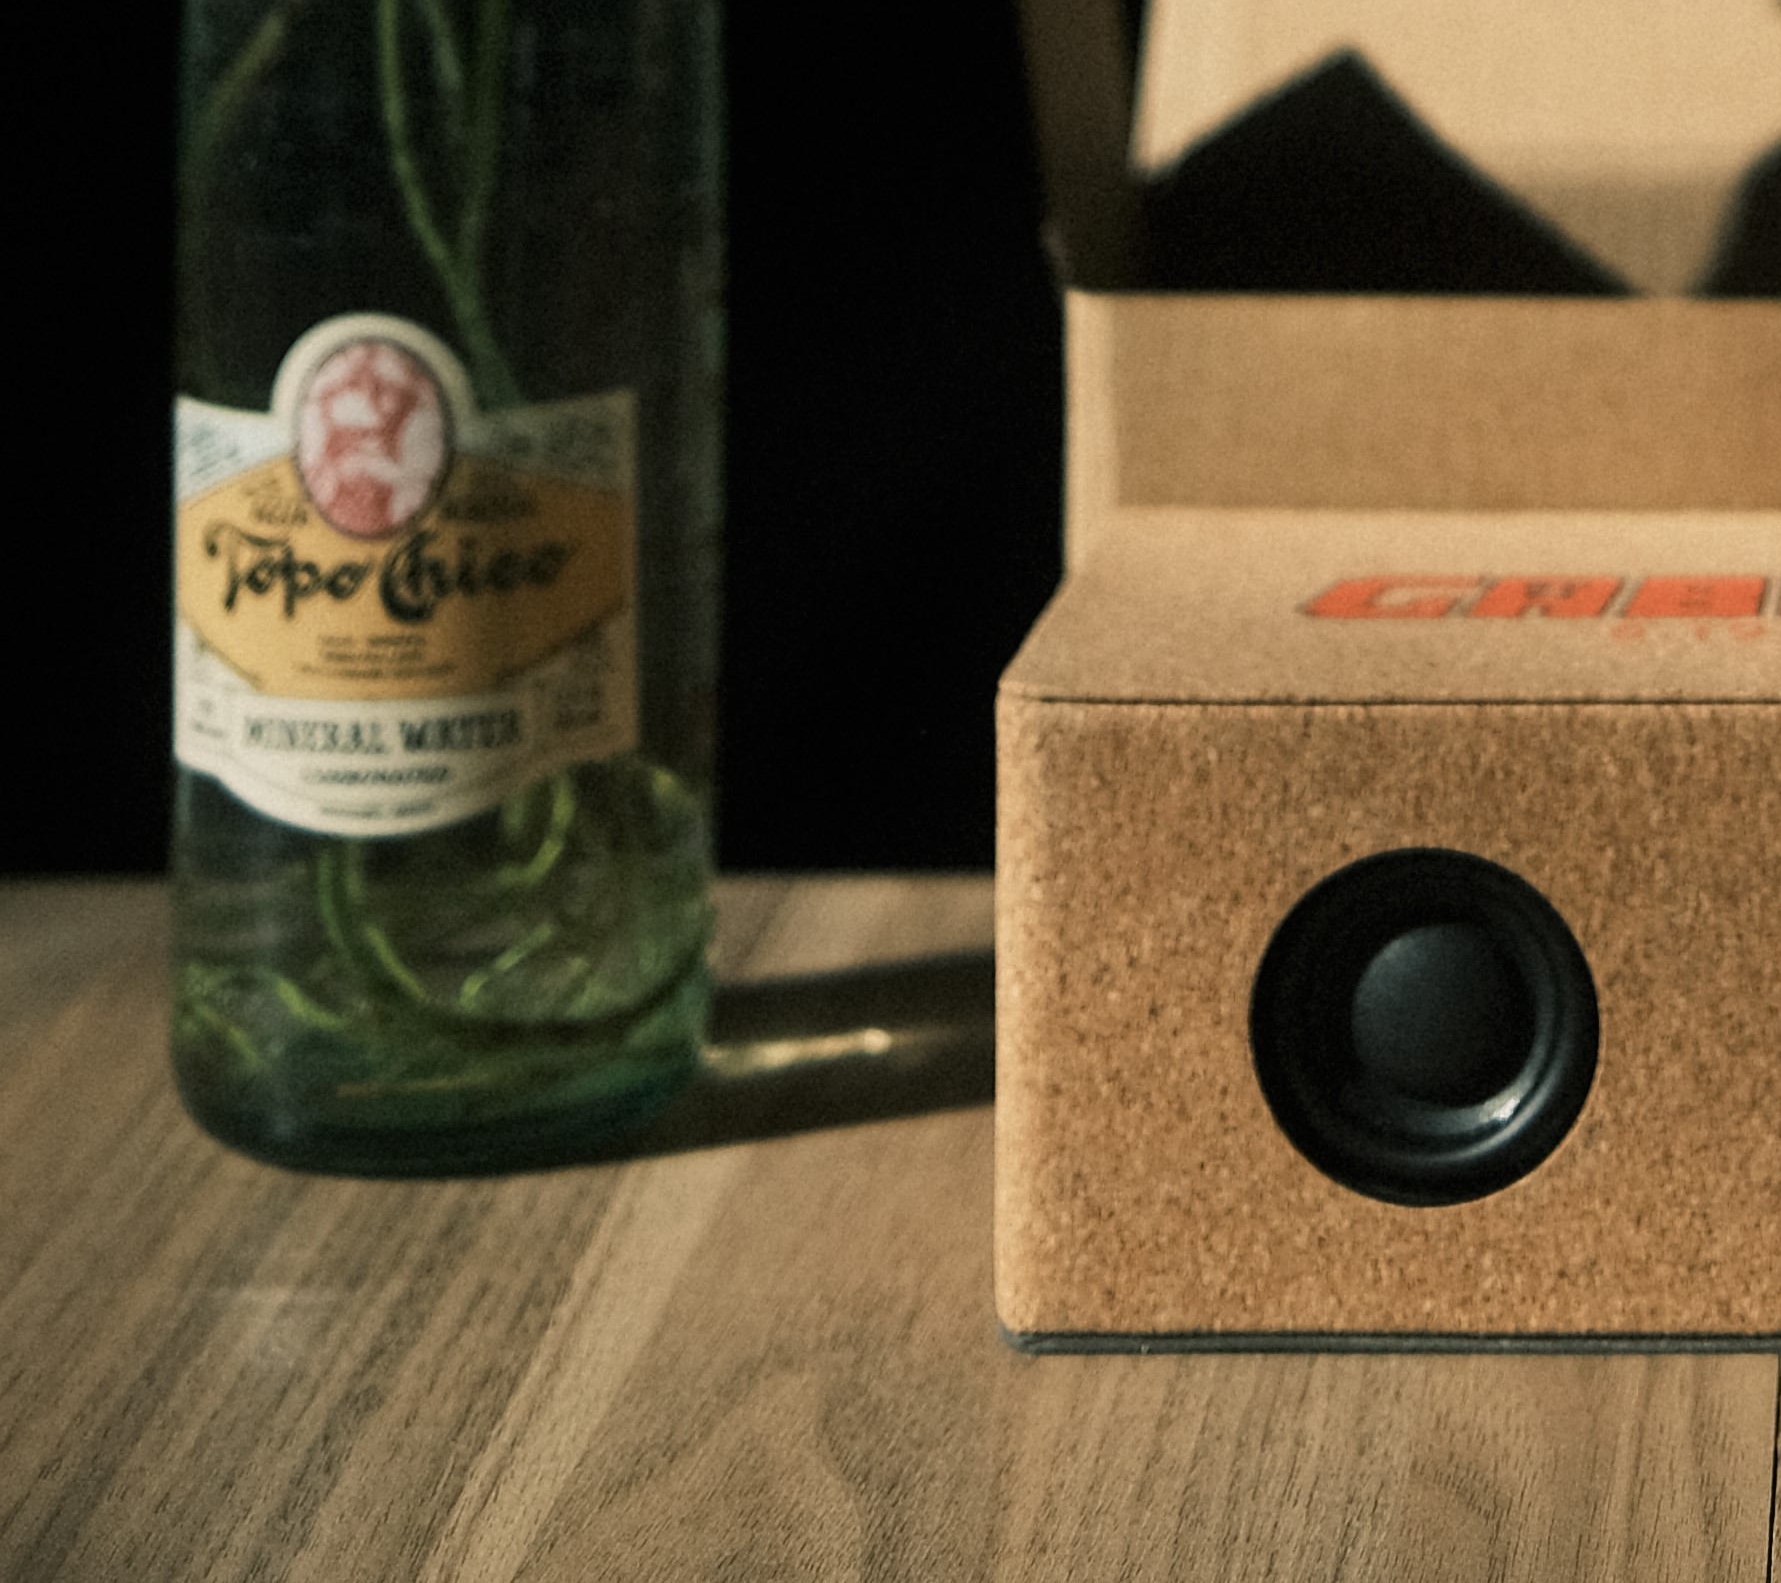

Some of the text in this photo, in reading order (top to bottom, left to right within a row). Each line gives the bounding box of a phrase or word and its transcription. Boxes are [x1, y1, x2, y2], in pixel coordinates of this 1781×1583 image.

[205, 521, 582, 625] Topo Chico
[244, 714, 388, 756] MINERAL
[398, 709, 521, 754] WATER
